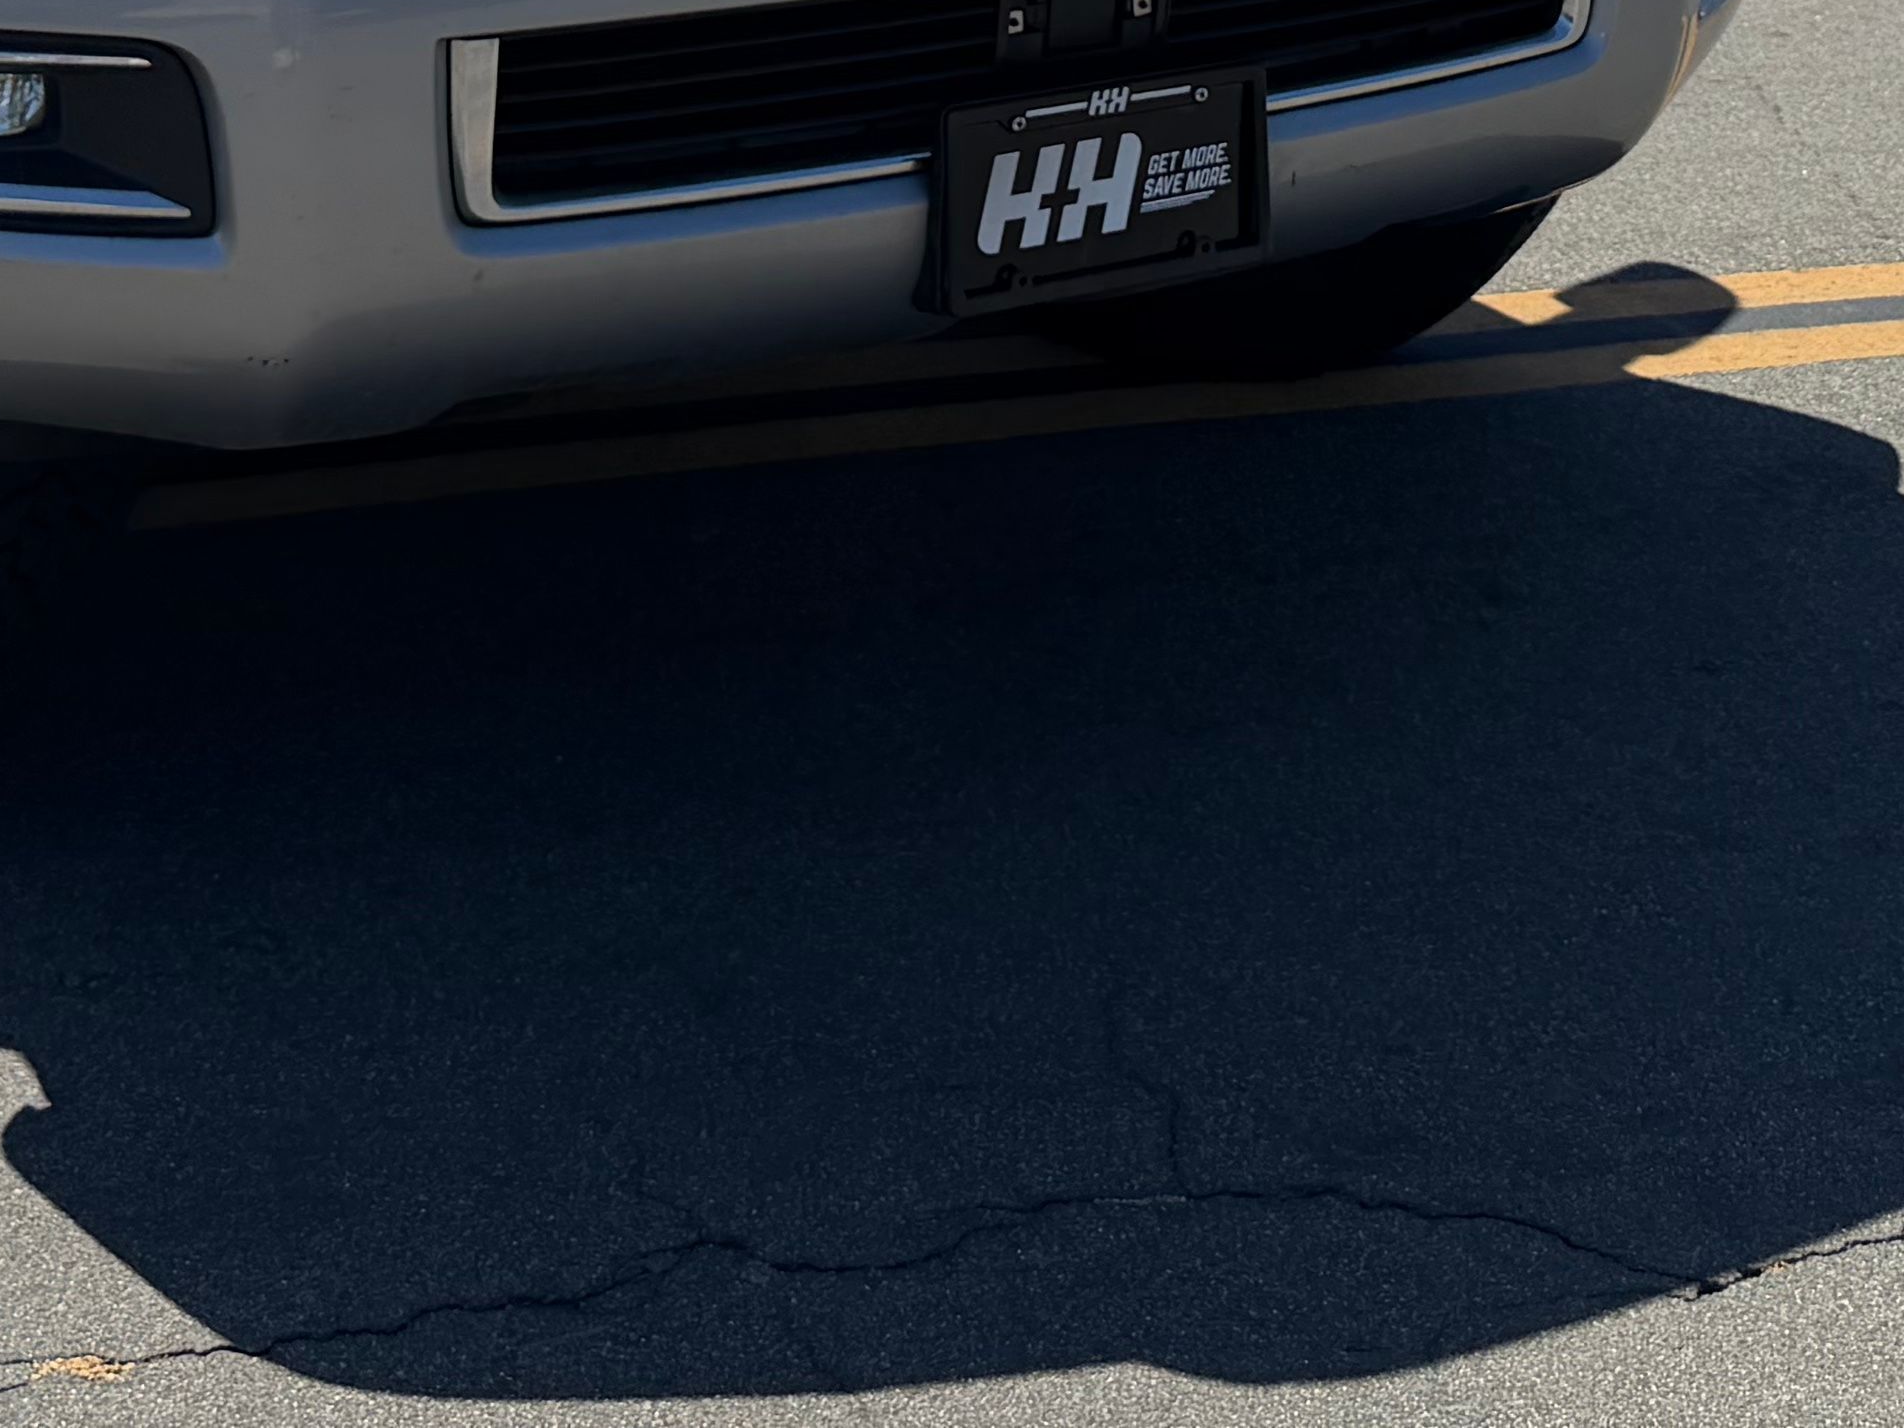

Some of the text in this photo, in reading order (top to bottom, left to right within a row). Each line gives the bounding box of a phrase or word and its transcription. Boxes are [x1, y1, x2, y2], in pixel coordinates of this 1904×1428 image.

[1148, 142, 1228, 175] GET MORE.
[1143, 165, 1232, 199] SAVE MORE.
